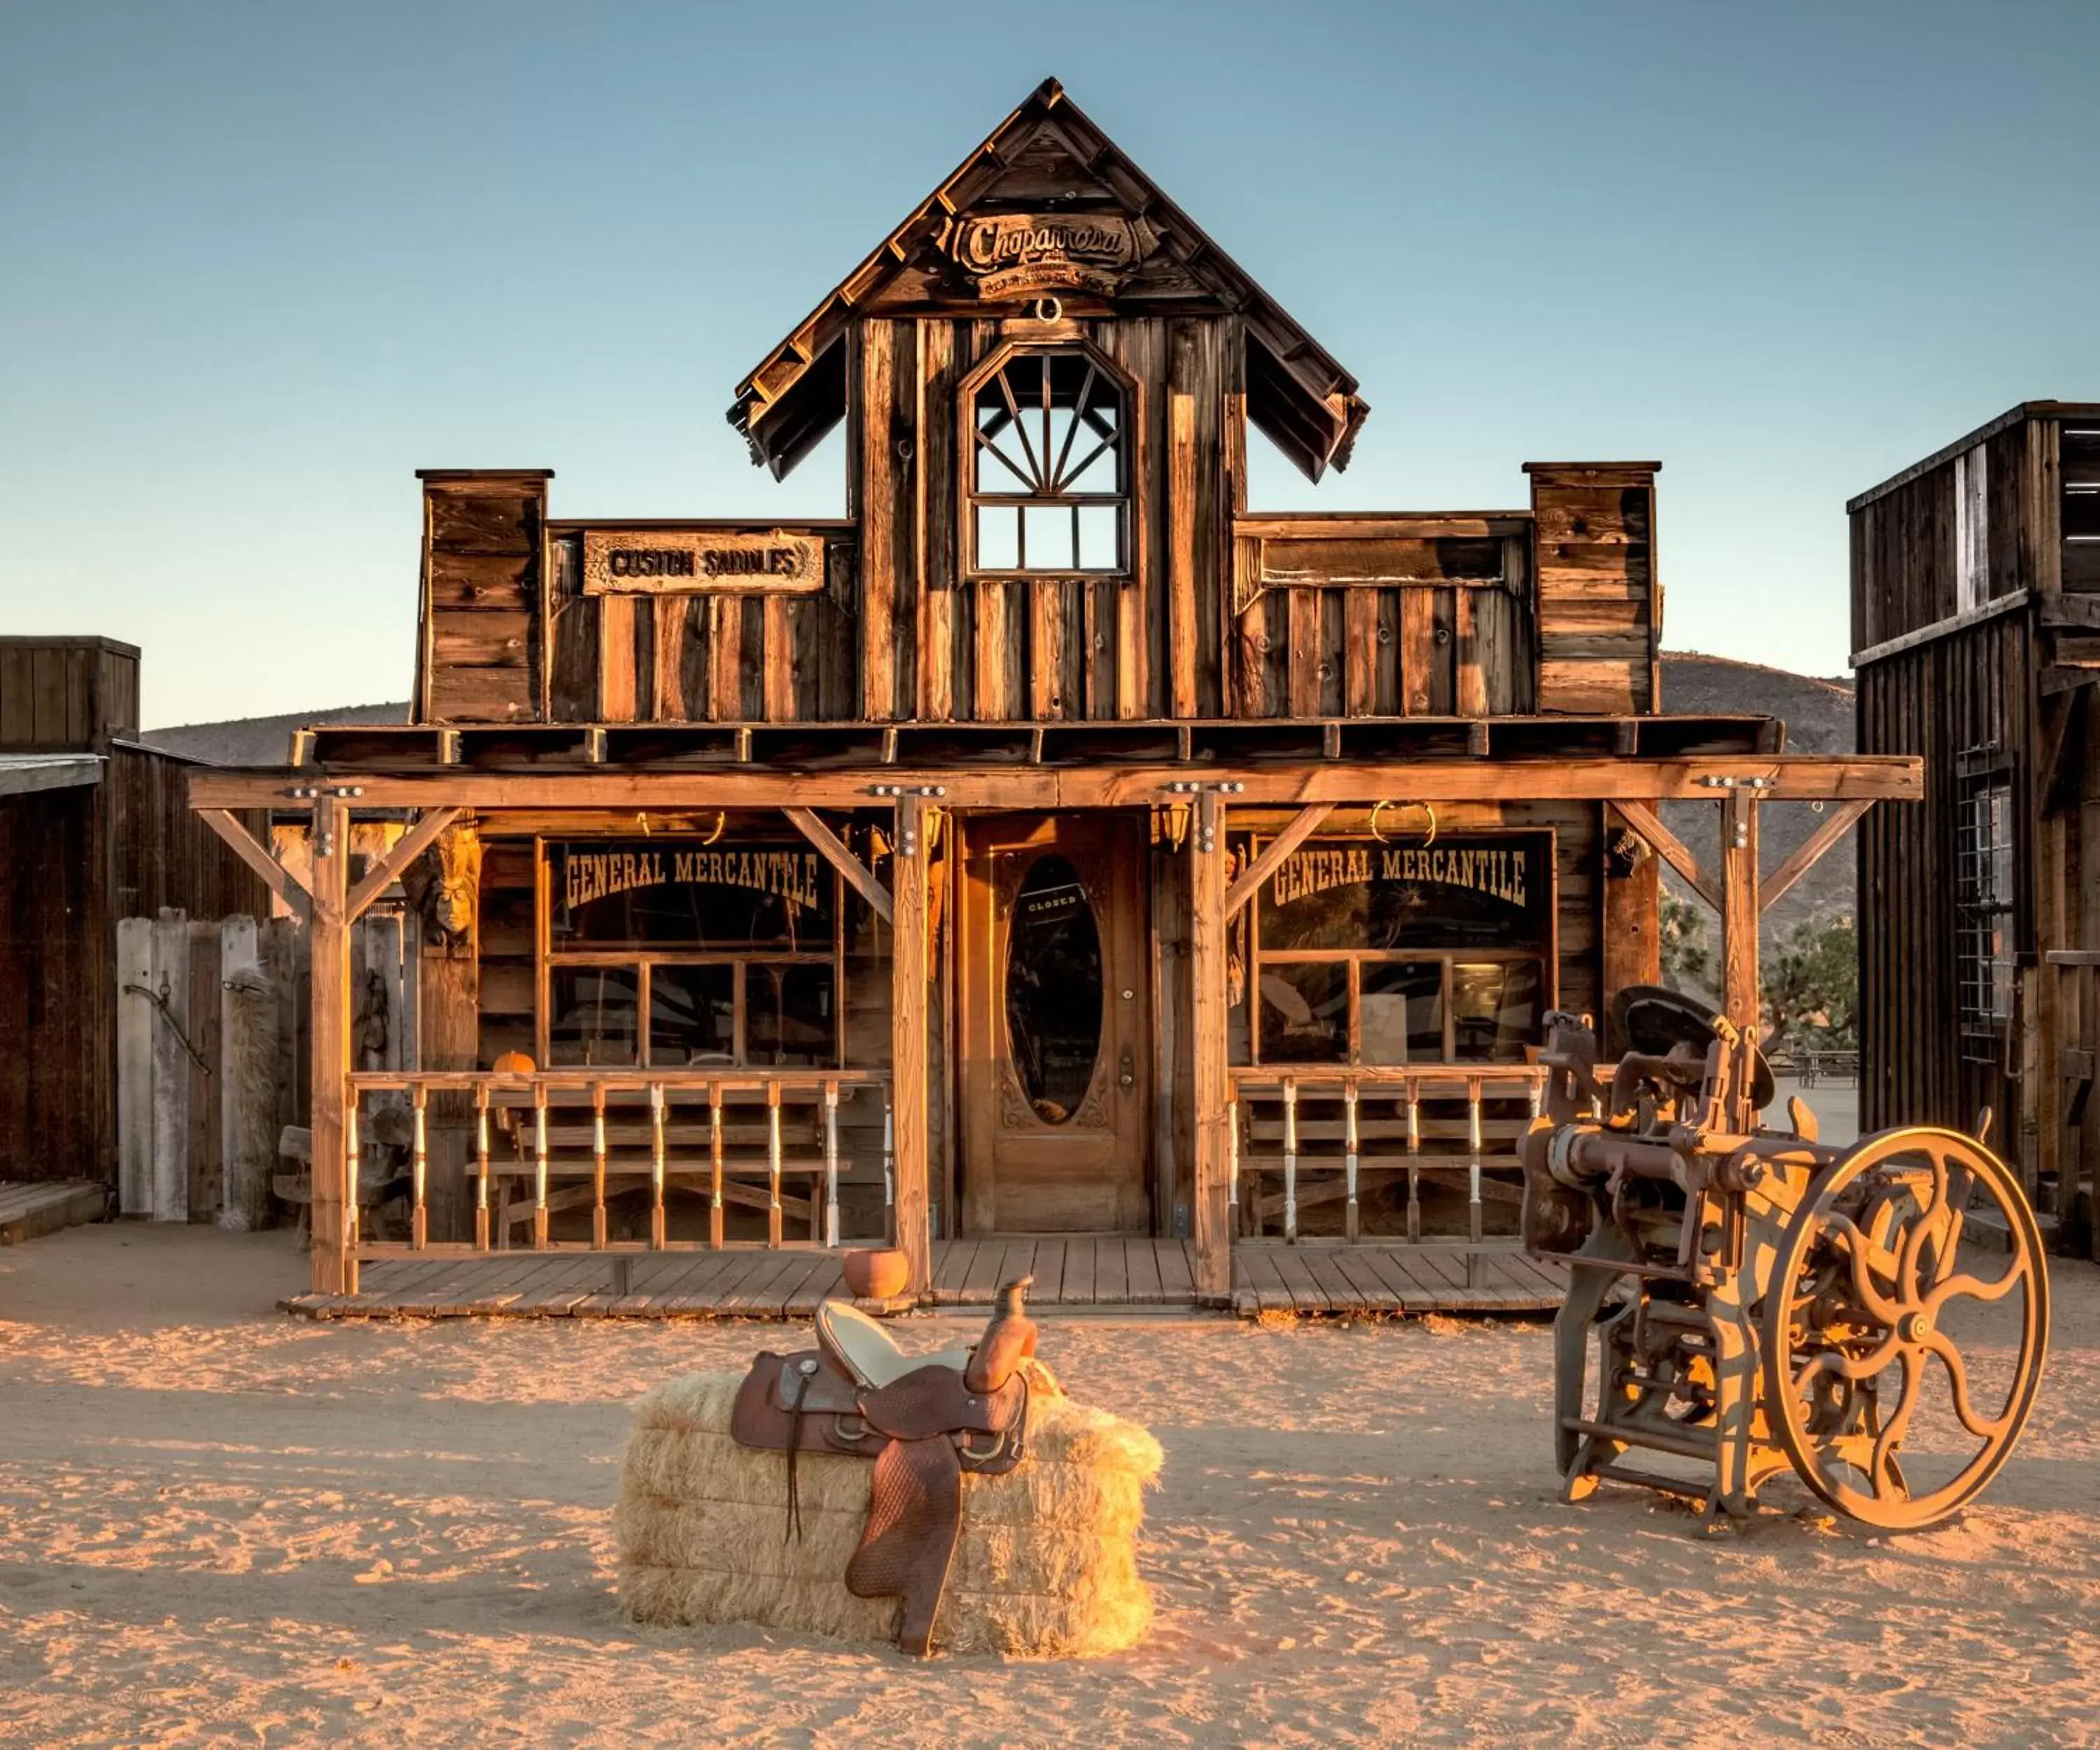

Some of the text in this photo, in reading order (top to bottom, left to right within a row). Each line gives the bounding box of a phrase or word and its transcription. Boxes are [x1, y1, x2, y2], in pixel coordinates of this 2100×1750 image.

[610, 548, 796, 577] CUSTOM SADDLES
[566, 851, 818, 910] GENERAL MERCANTILE
[1275, 850, 1526, 908] GENERAL MERCANTILE
[1028, 896, 1076, 912] CLOSED
